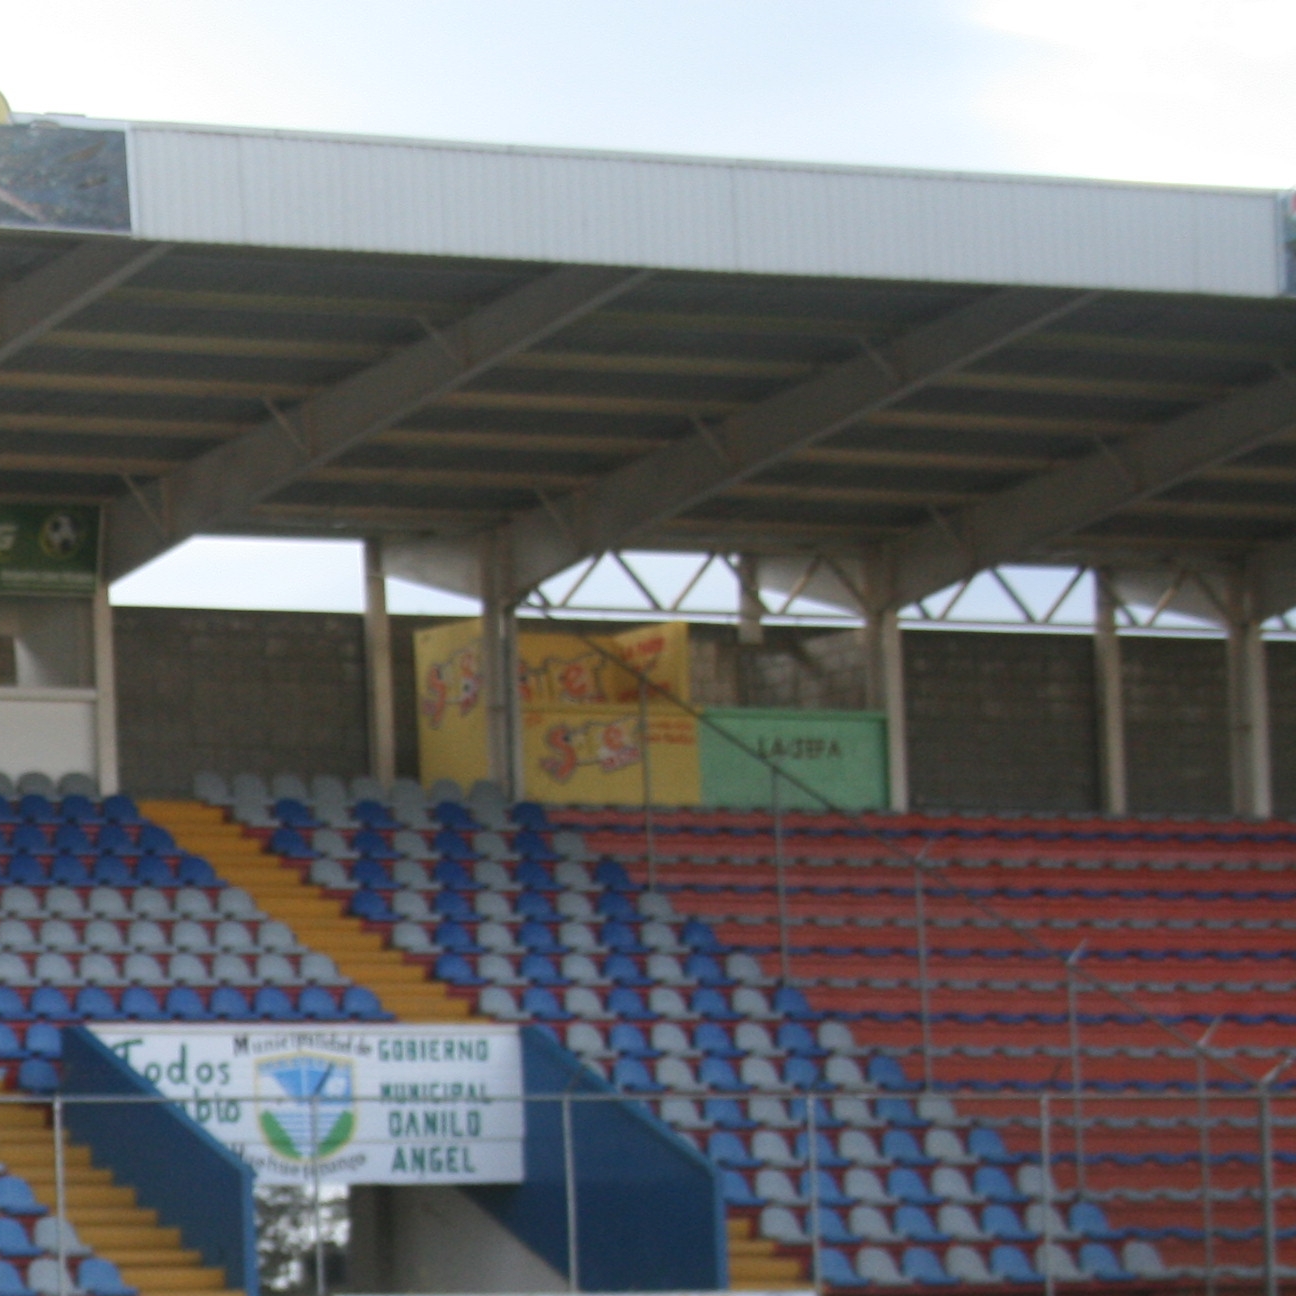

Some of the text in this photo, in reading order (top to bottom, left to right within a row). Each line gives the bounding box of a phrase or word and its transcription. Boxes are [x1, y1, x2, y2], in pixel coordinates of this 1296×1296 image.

[377, 1038, 490, 1063] GOBIERNO
[380, 1081, 493, 1107] MUNICIPAL
[388, 1109, 482, 1138] DANILO
[391, 1146, 477, 1174] ANGEL
